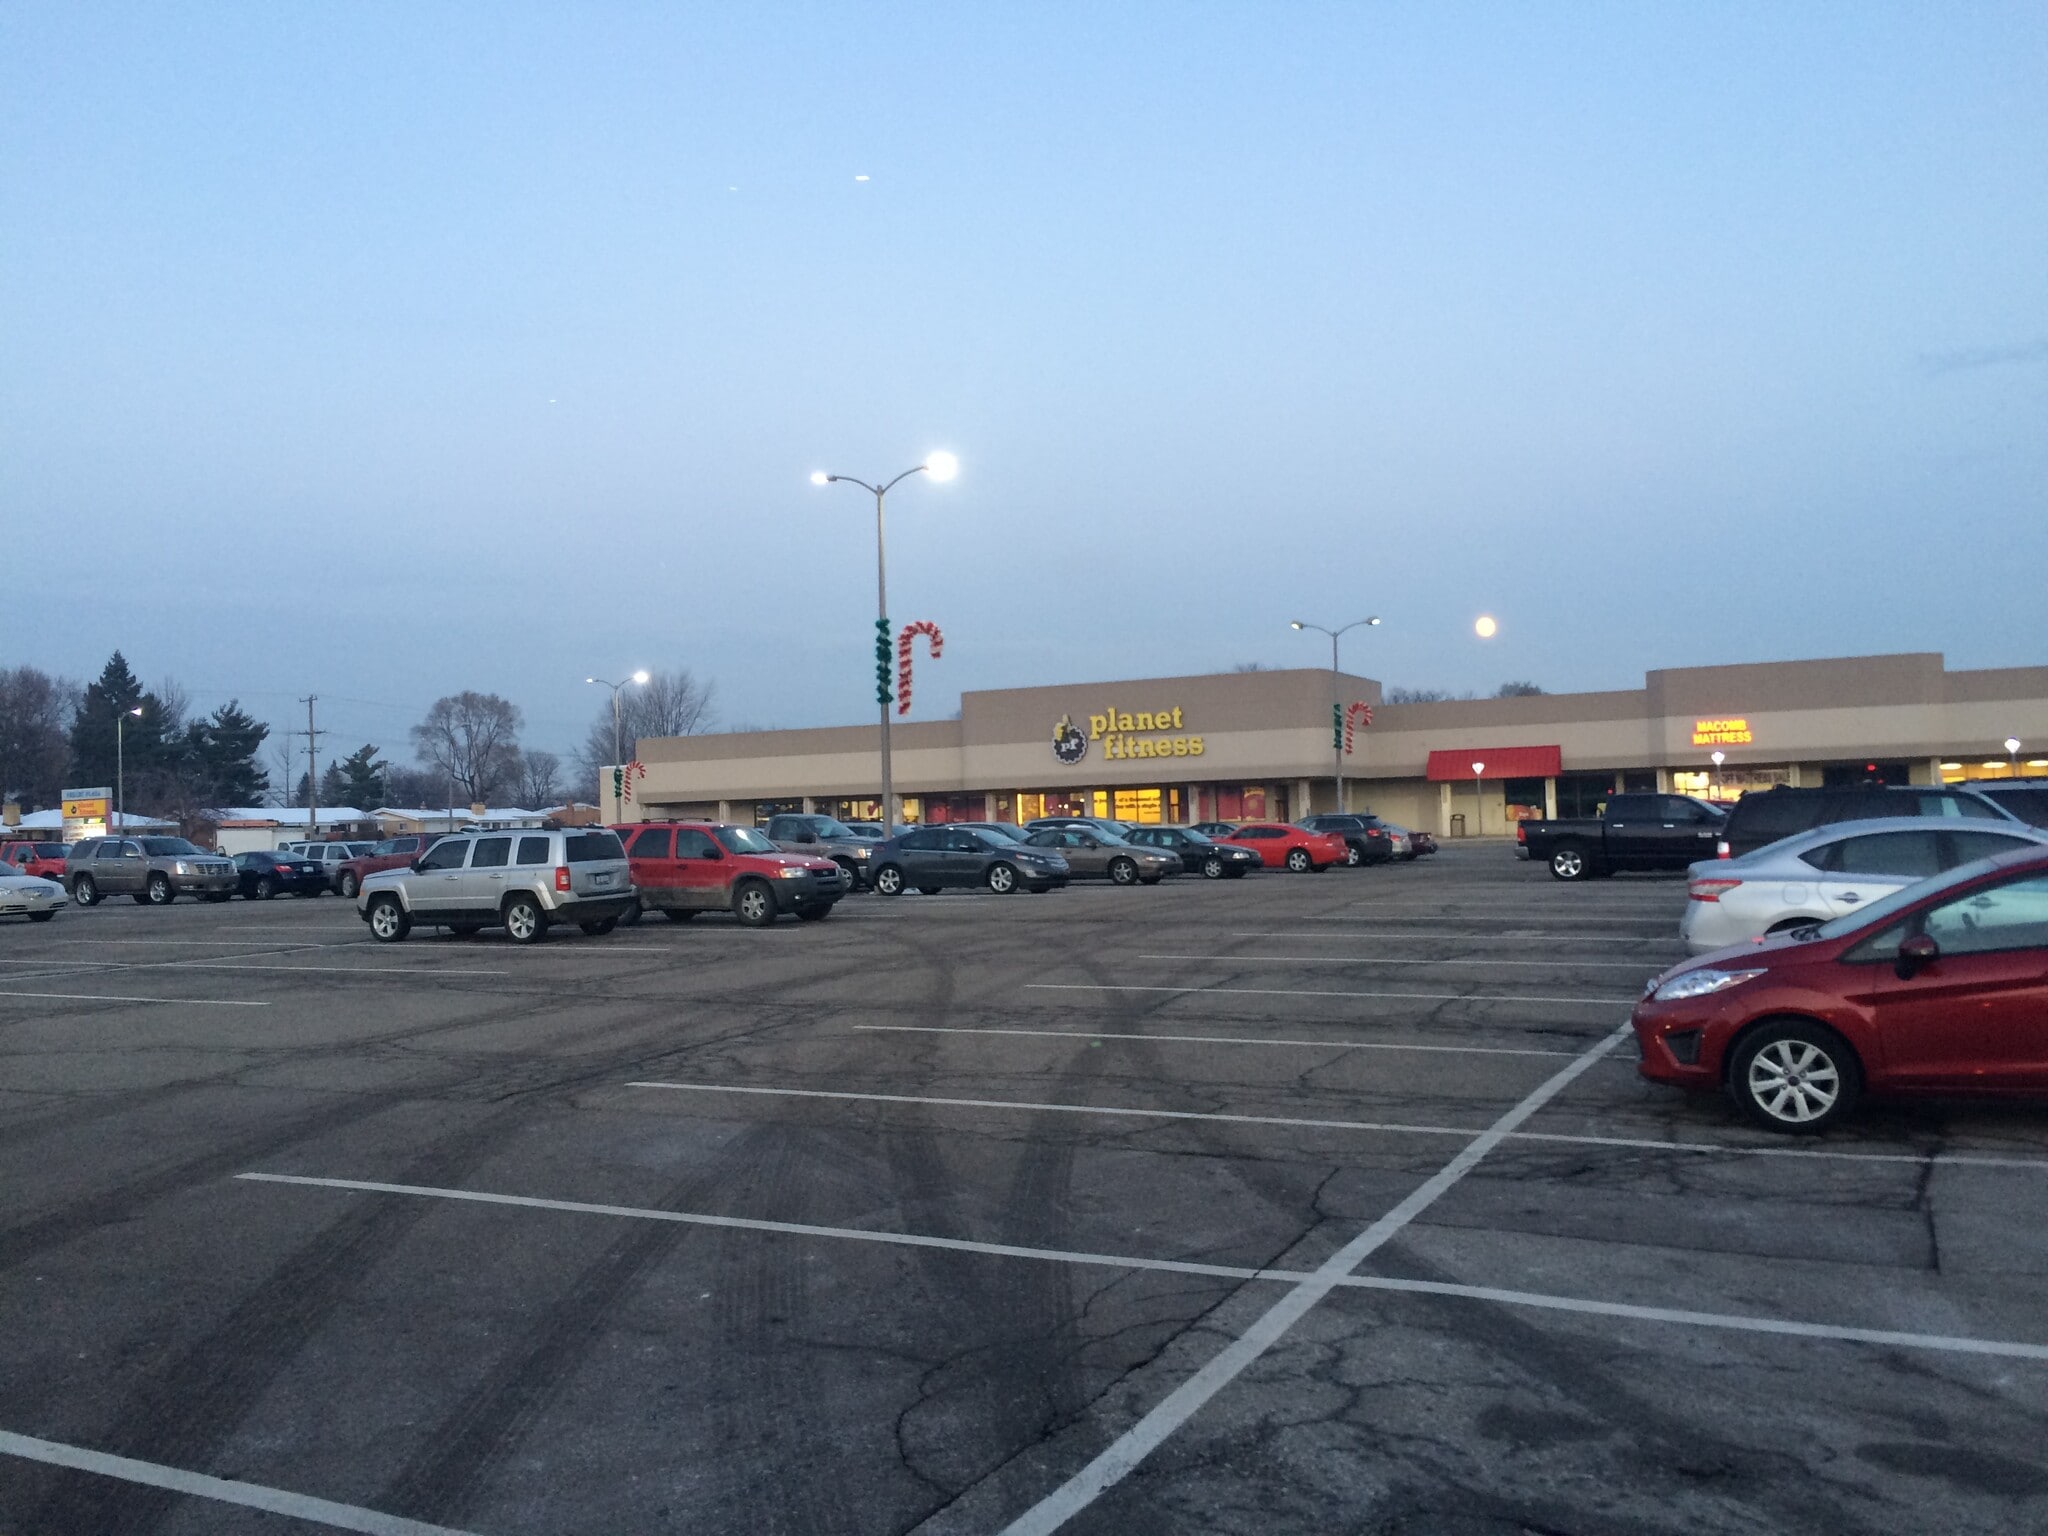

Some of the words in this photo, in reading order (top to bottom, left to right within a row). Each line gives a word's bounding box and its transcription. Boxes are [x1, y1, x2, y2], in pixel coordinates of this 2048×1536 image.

[1089, 705, 1182, 739] planet
[1696, 719, 1747, 732] MACOMB
[1060, 738, 1079, 752] pf
[1693, 731, 1752, 745] MATTRESS
[1104, 734, 1204, 759] fitness
